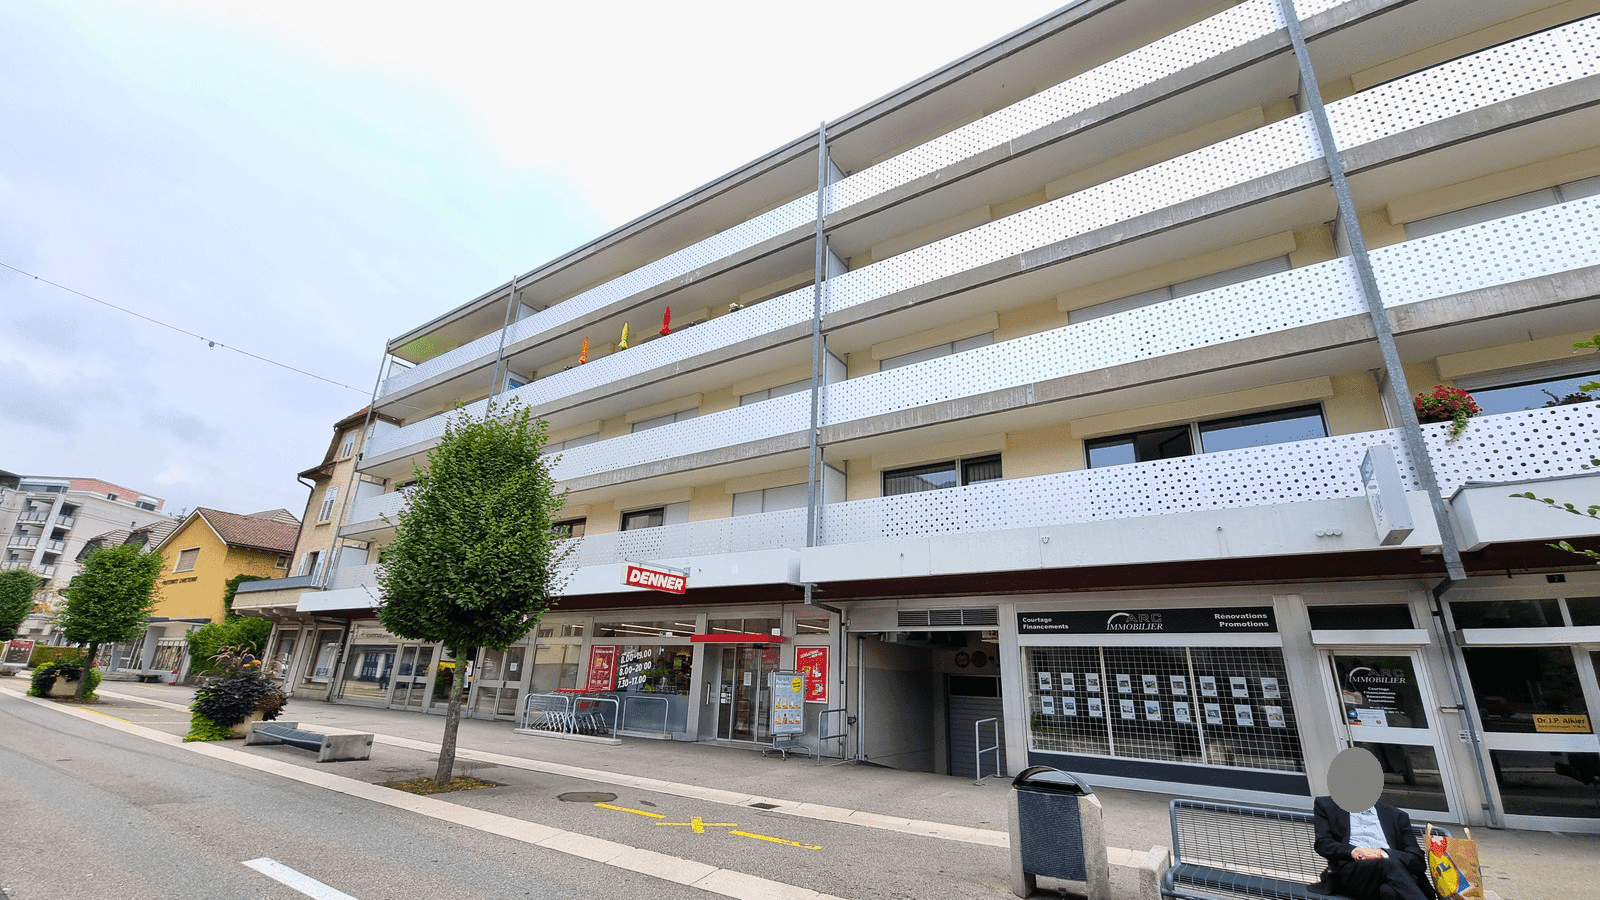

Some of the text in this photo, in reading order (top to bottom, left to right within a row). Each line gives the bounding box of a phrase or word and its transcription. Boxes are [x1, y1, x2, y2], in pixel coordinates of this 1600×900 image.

[629, 569, 684, 590] DENNER
[1126, 613, 1162, 622] ARC
[1107, 623, 1163, 631] IMMOBILIER
[619, 661, 652, 676] 8.00-2000
